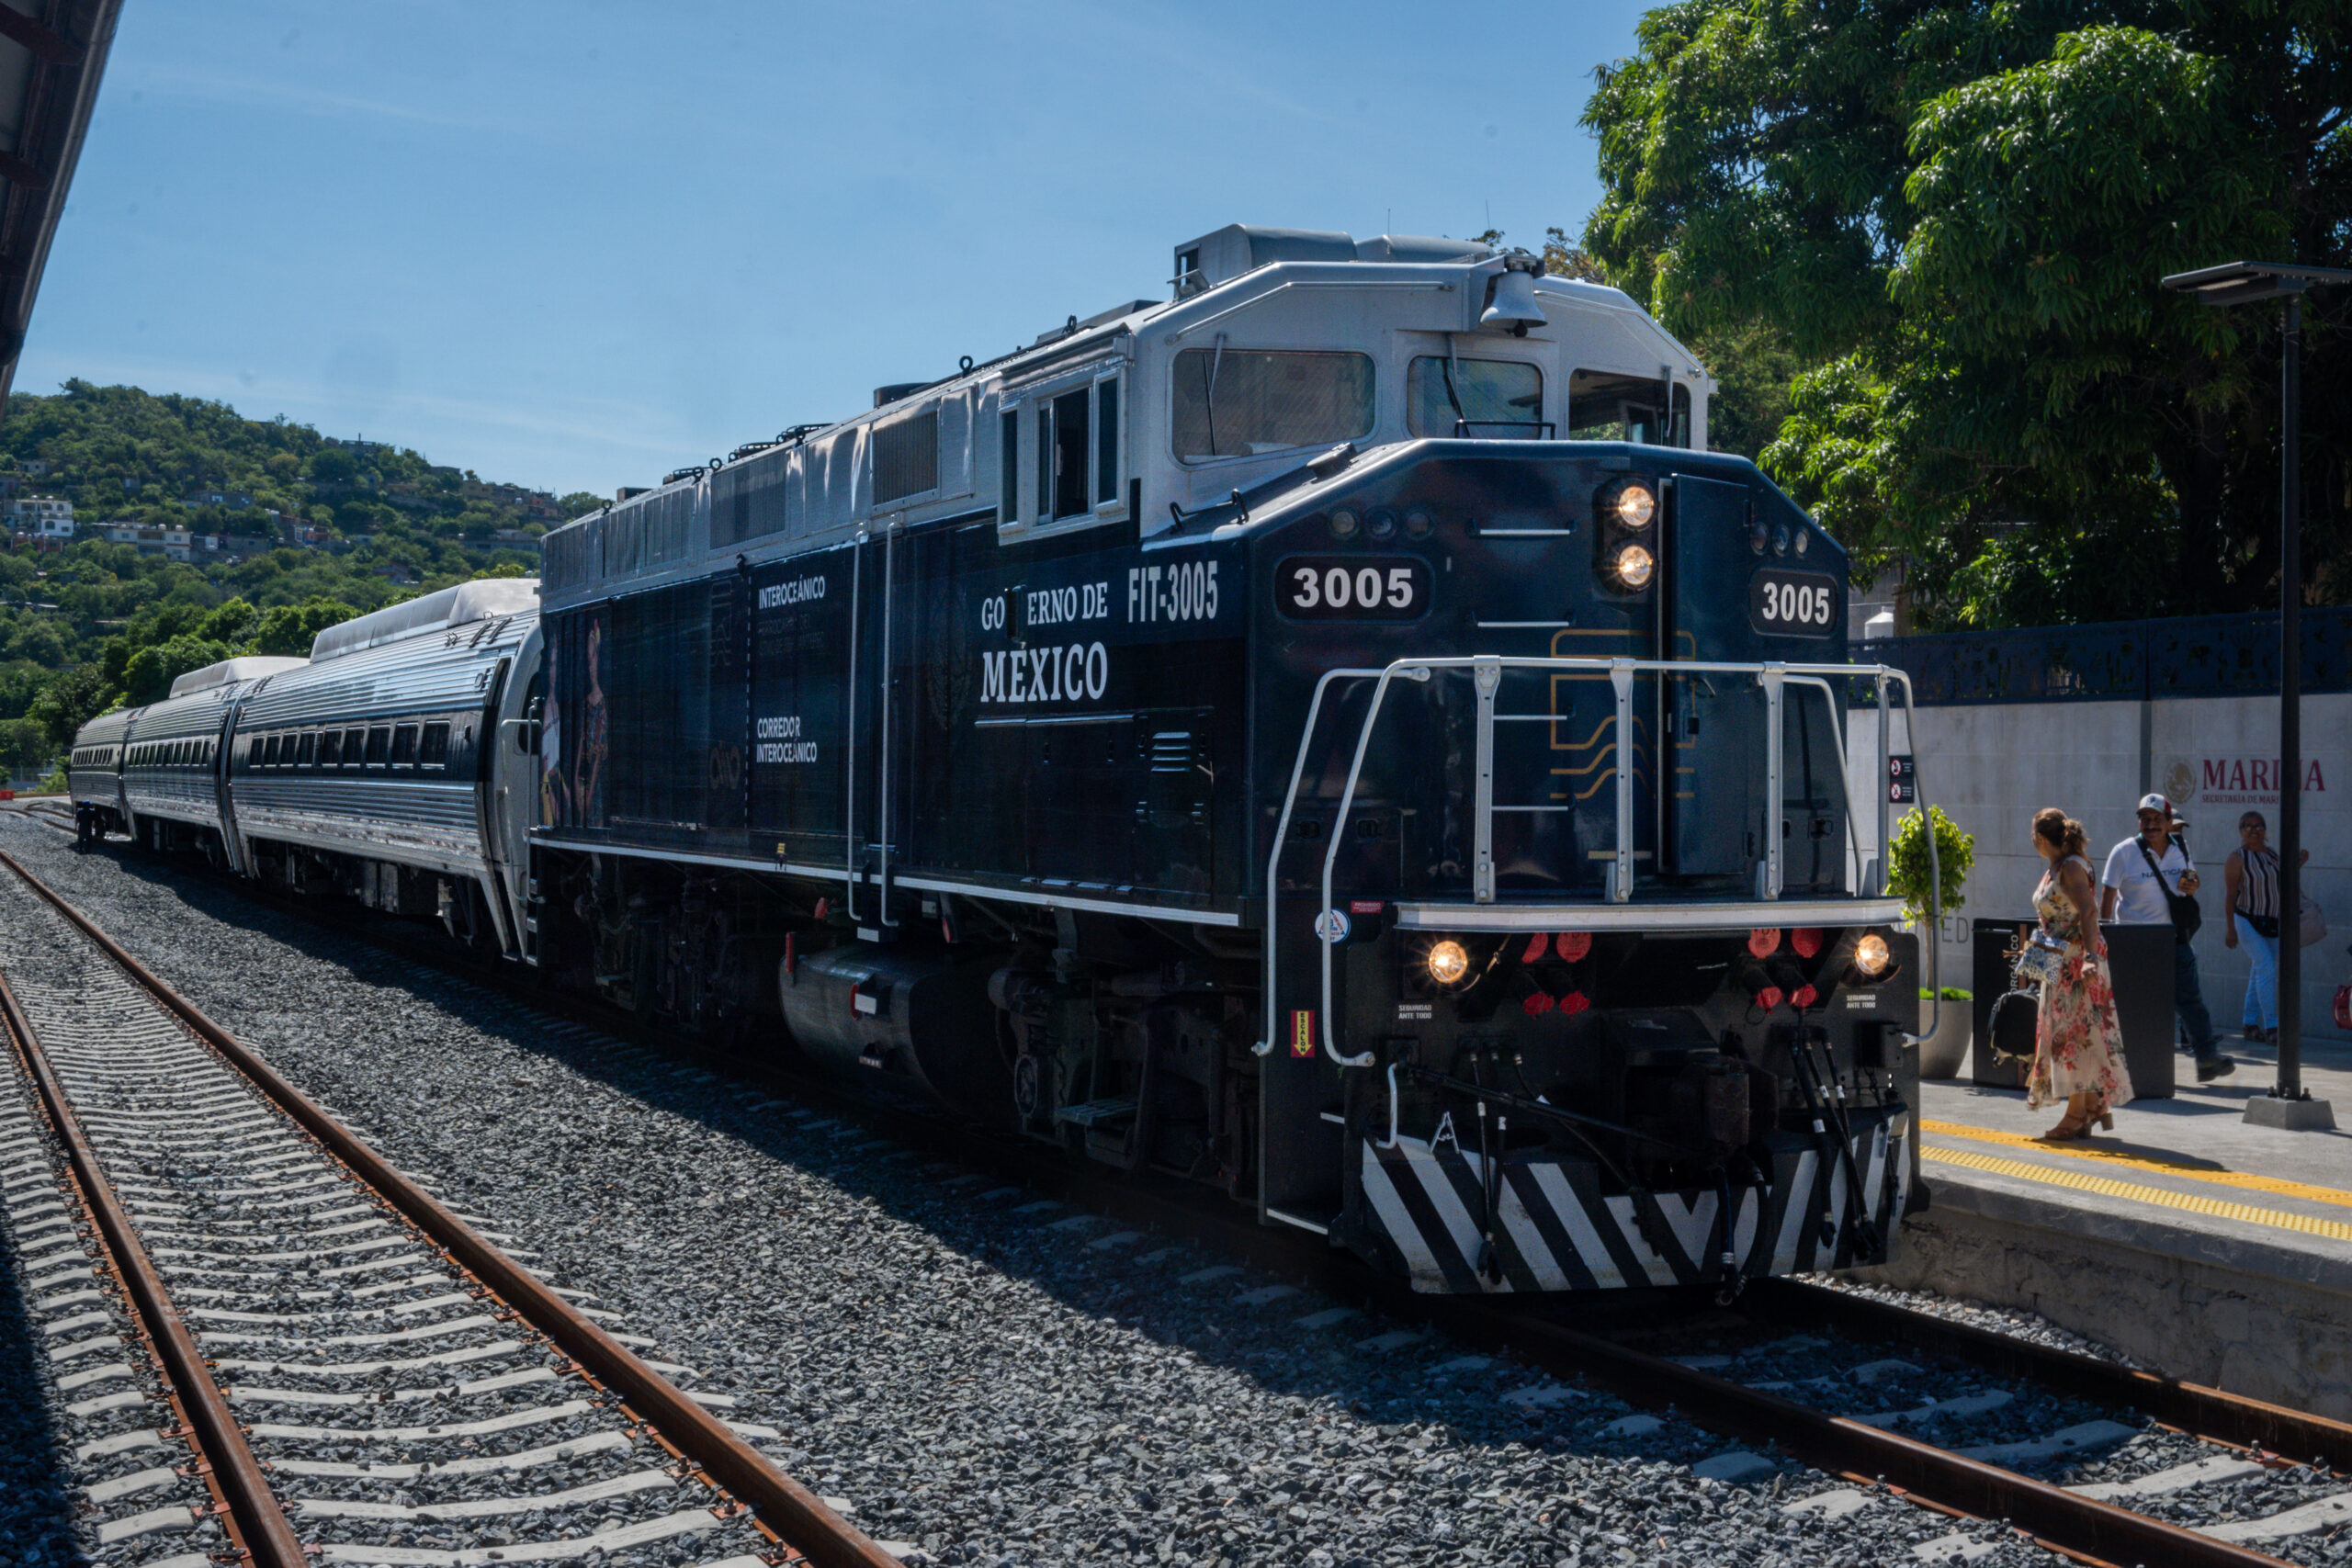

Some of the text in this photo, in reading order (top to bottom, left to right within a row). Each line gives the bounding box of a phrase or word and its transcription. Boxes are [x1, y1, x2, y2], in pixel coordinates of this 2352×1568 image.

[758, 573, 826, 610] INTEROCEÁNICO
[981, 581, 1109, 631] GOERNO DE
[1128, 560, 1218, 623] FIT-3005
[1293, 567, 1414, 608] 3005
[1762, 581, 1830, 625] 3005
[980, 641, 1109, 703] MÉXICO
[757, 716, 801, 739] CORREDOR
[756, 738, 818, 763] INTEROCEÁNICO
[2202, 759, 2326, 792] MARIA
[2247, 795, 2257, 804] DE
